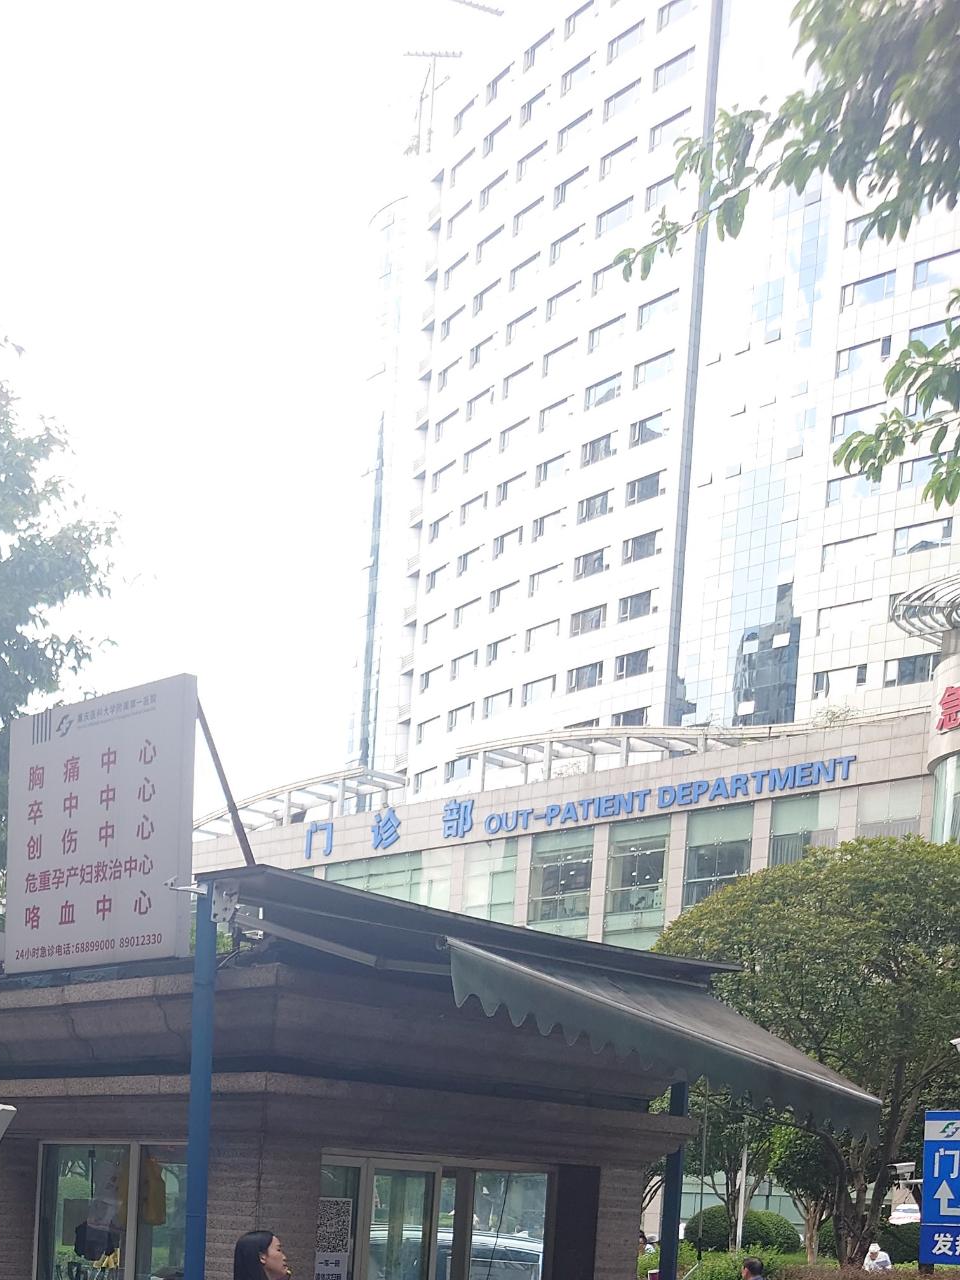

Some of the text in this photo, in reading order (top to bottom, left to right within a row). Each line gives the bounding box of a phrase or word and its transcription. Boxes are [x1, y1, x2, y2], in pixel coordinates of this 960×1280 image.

[28, 739, 157, 792] 胸痛中心
[27, 776, 156, 826] 卒中中心
[484, 755, 856, 835] OUT-PATIENT DEPARTMENT
[26, 814, 155, 861] 创伤中心
[304, 799, 475, 860] 门诊部
[24, 854, 154, 894] 危重孕产妇救治中心
[24, 890, 152, 930] 咯血中心
[119, 933, 163, 949] 89012330
